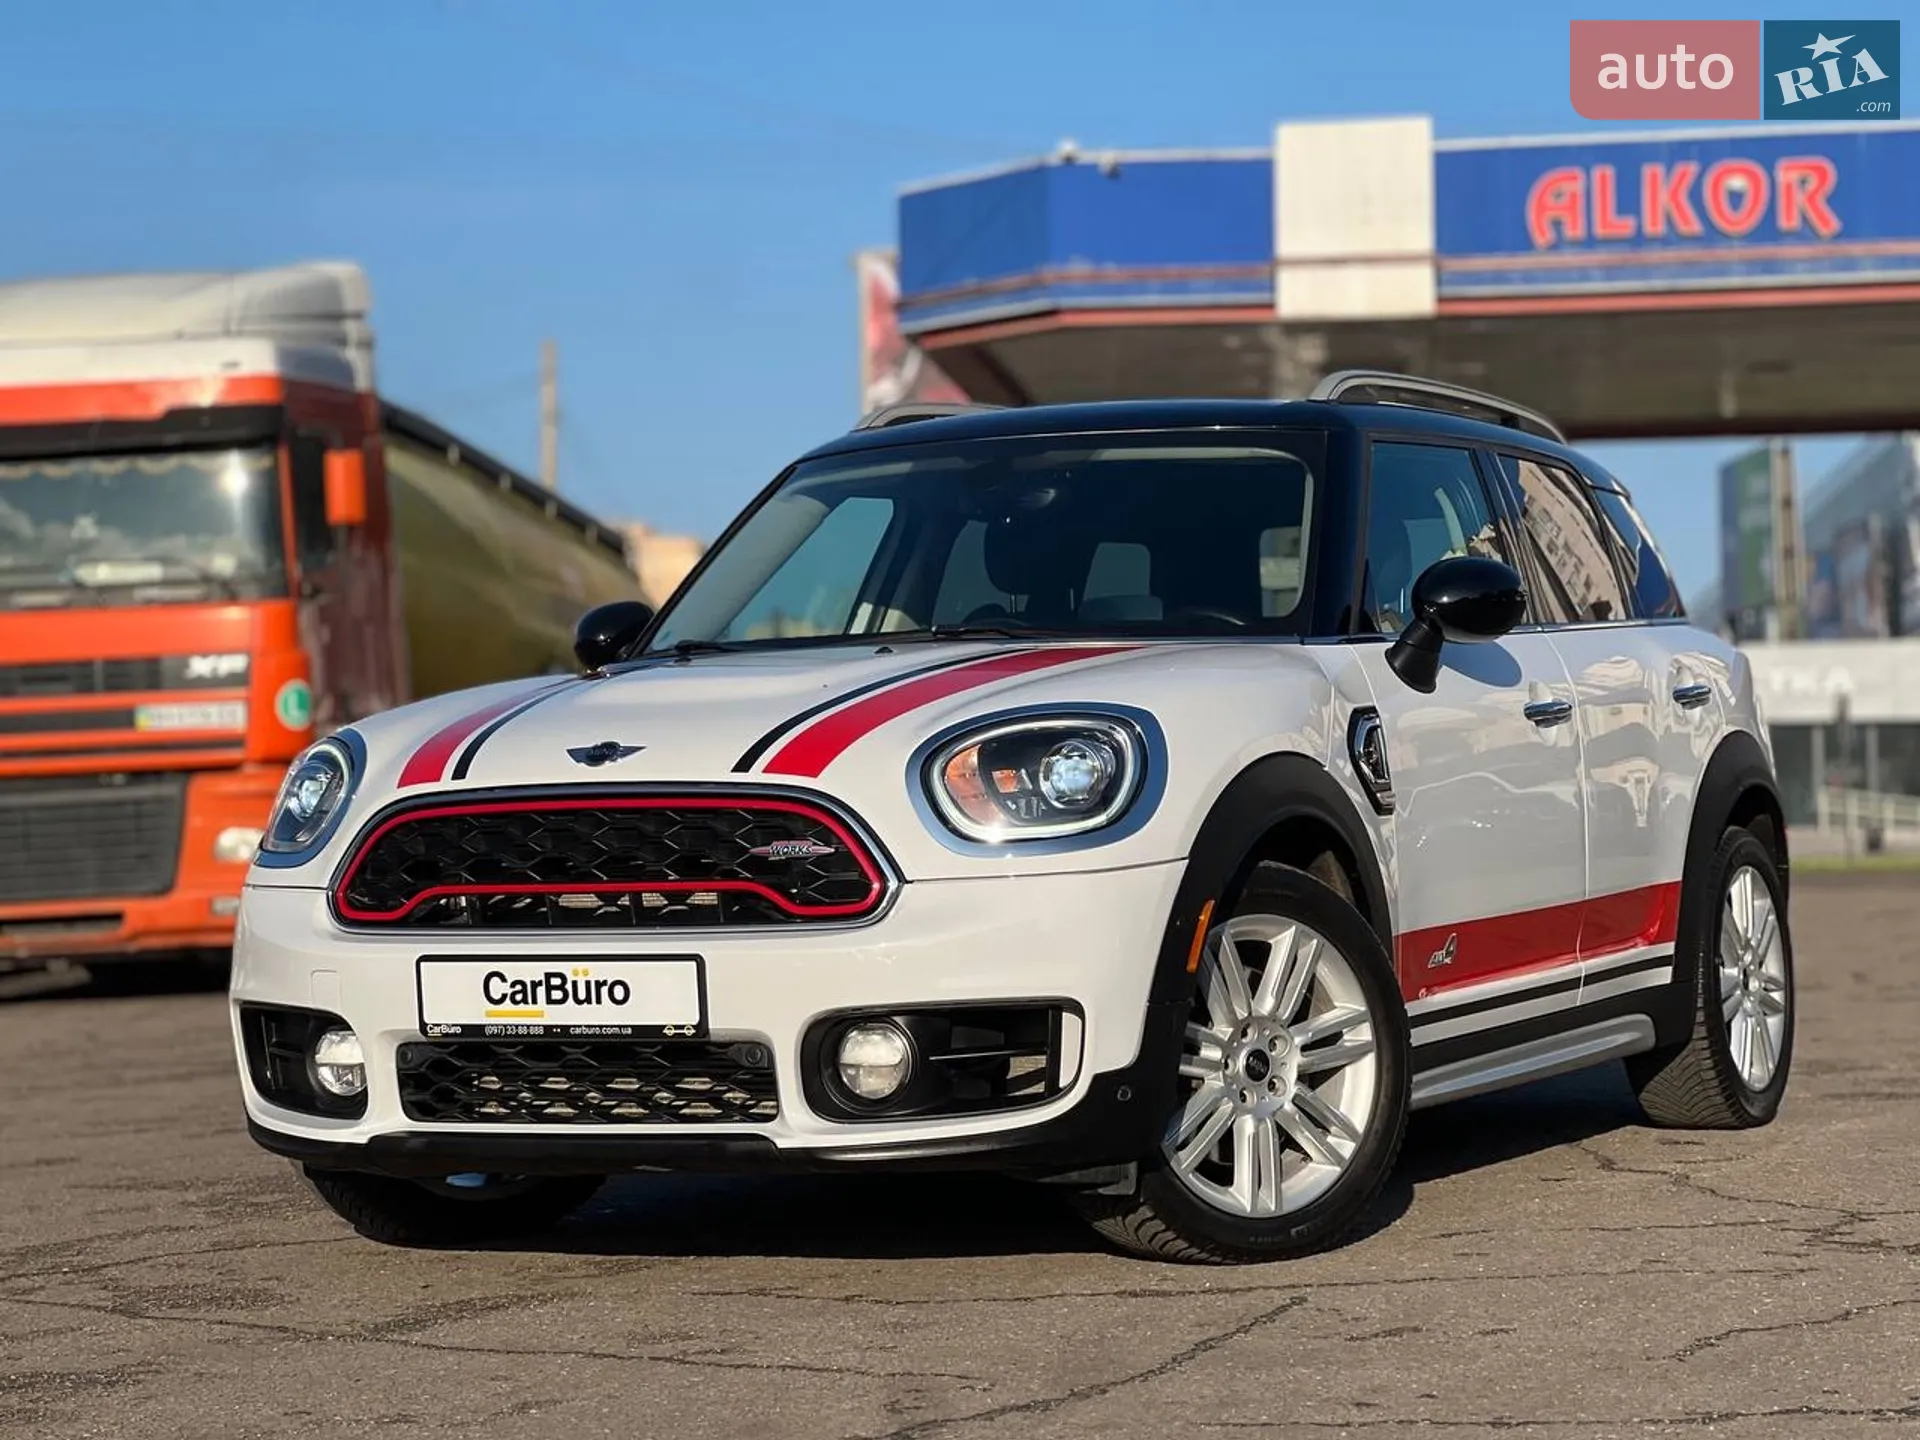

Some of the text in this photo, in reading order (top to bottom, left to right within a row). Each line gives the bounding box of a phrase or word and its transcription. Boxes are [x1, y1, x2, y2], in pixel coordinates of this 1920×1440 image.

[1525, 156, 1842, 249] ALKOR
[483, 968, 630, 1006] CarBüro
[484, 1025, 506, 1036] (097)
[506, 1025, 544, 1035] 33-88-888
[569, 1024, 632, 1035] carburo.com.ua
